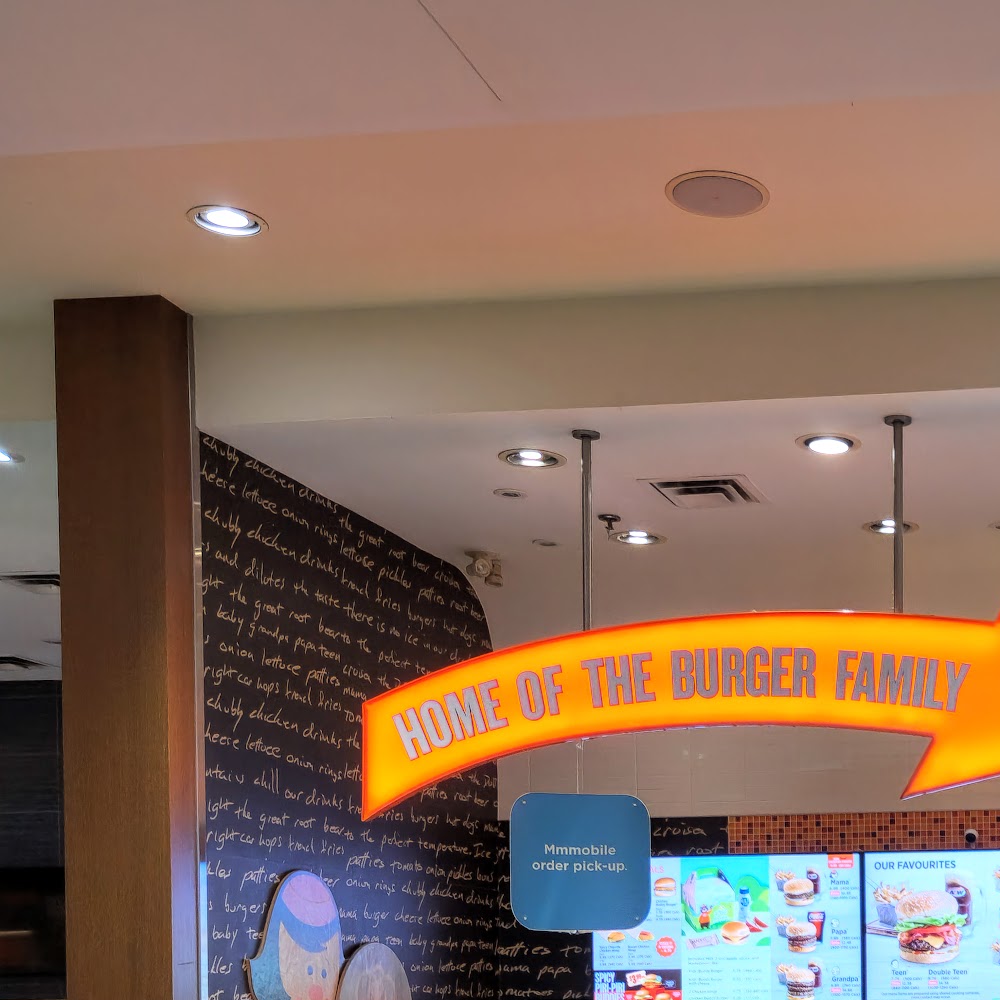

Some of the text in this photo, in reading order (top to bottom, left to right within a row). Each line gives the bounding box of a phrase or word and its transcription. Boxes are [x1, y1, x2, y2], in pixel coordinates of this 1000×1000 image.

[204, 507, 339, 577] chubby chicken drinks
[215, 550, 239, 568] and
[315, 590, 340, 608] taste
[343, 602, 373, 626] there
[391, 646, 972, 762] HOME OF THE BURGER FAMILY
[544, 844, 616, 856] Mmmobile
[532, 860, 628, 873] order pick-up.
[874, 860, 957, 871] OUR FAVOURITES
[224, 893, 267, 922] burgers
[212, 924, 238, 948] baby
[831, 928, 848, 936] Papa
[594, 972, 615, 984] SPICY
[831, 975, 859, 983] Grandpa
